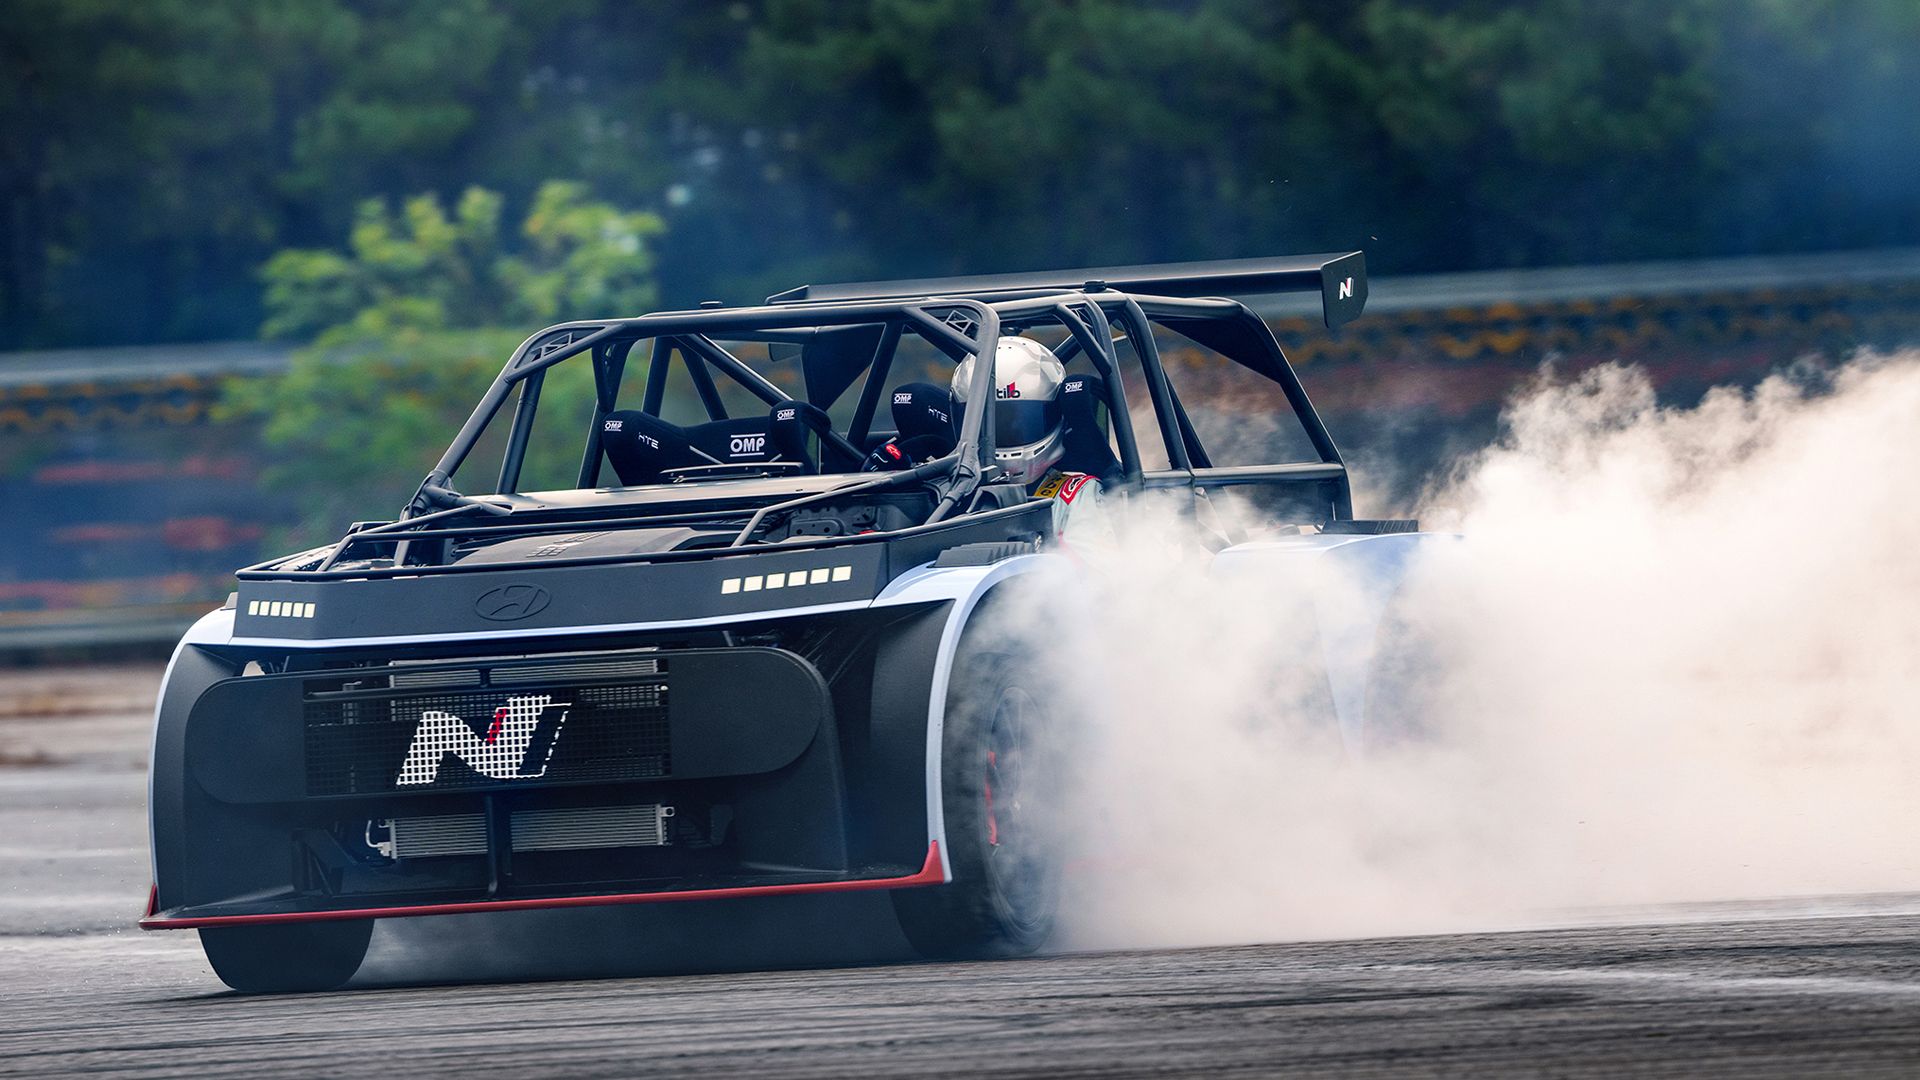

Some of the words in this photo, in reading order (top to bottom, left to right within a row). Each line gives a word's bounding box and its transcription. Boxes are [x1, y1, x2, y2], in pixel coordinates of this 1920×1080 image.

[1339, 277, 1354, 300] N
[996, 384, 1020, 398] tilo
[1065, 383, 1083, 392] OMP
[894, 394, 911, 403] OMP
[777, 410, 795, 419] OMP
[605, 422, 622, 430] OMP
[730, 436, 765, 453] OMP
